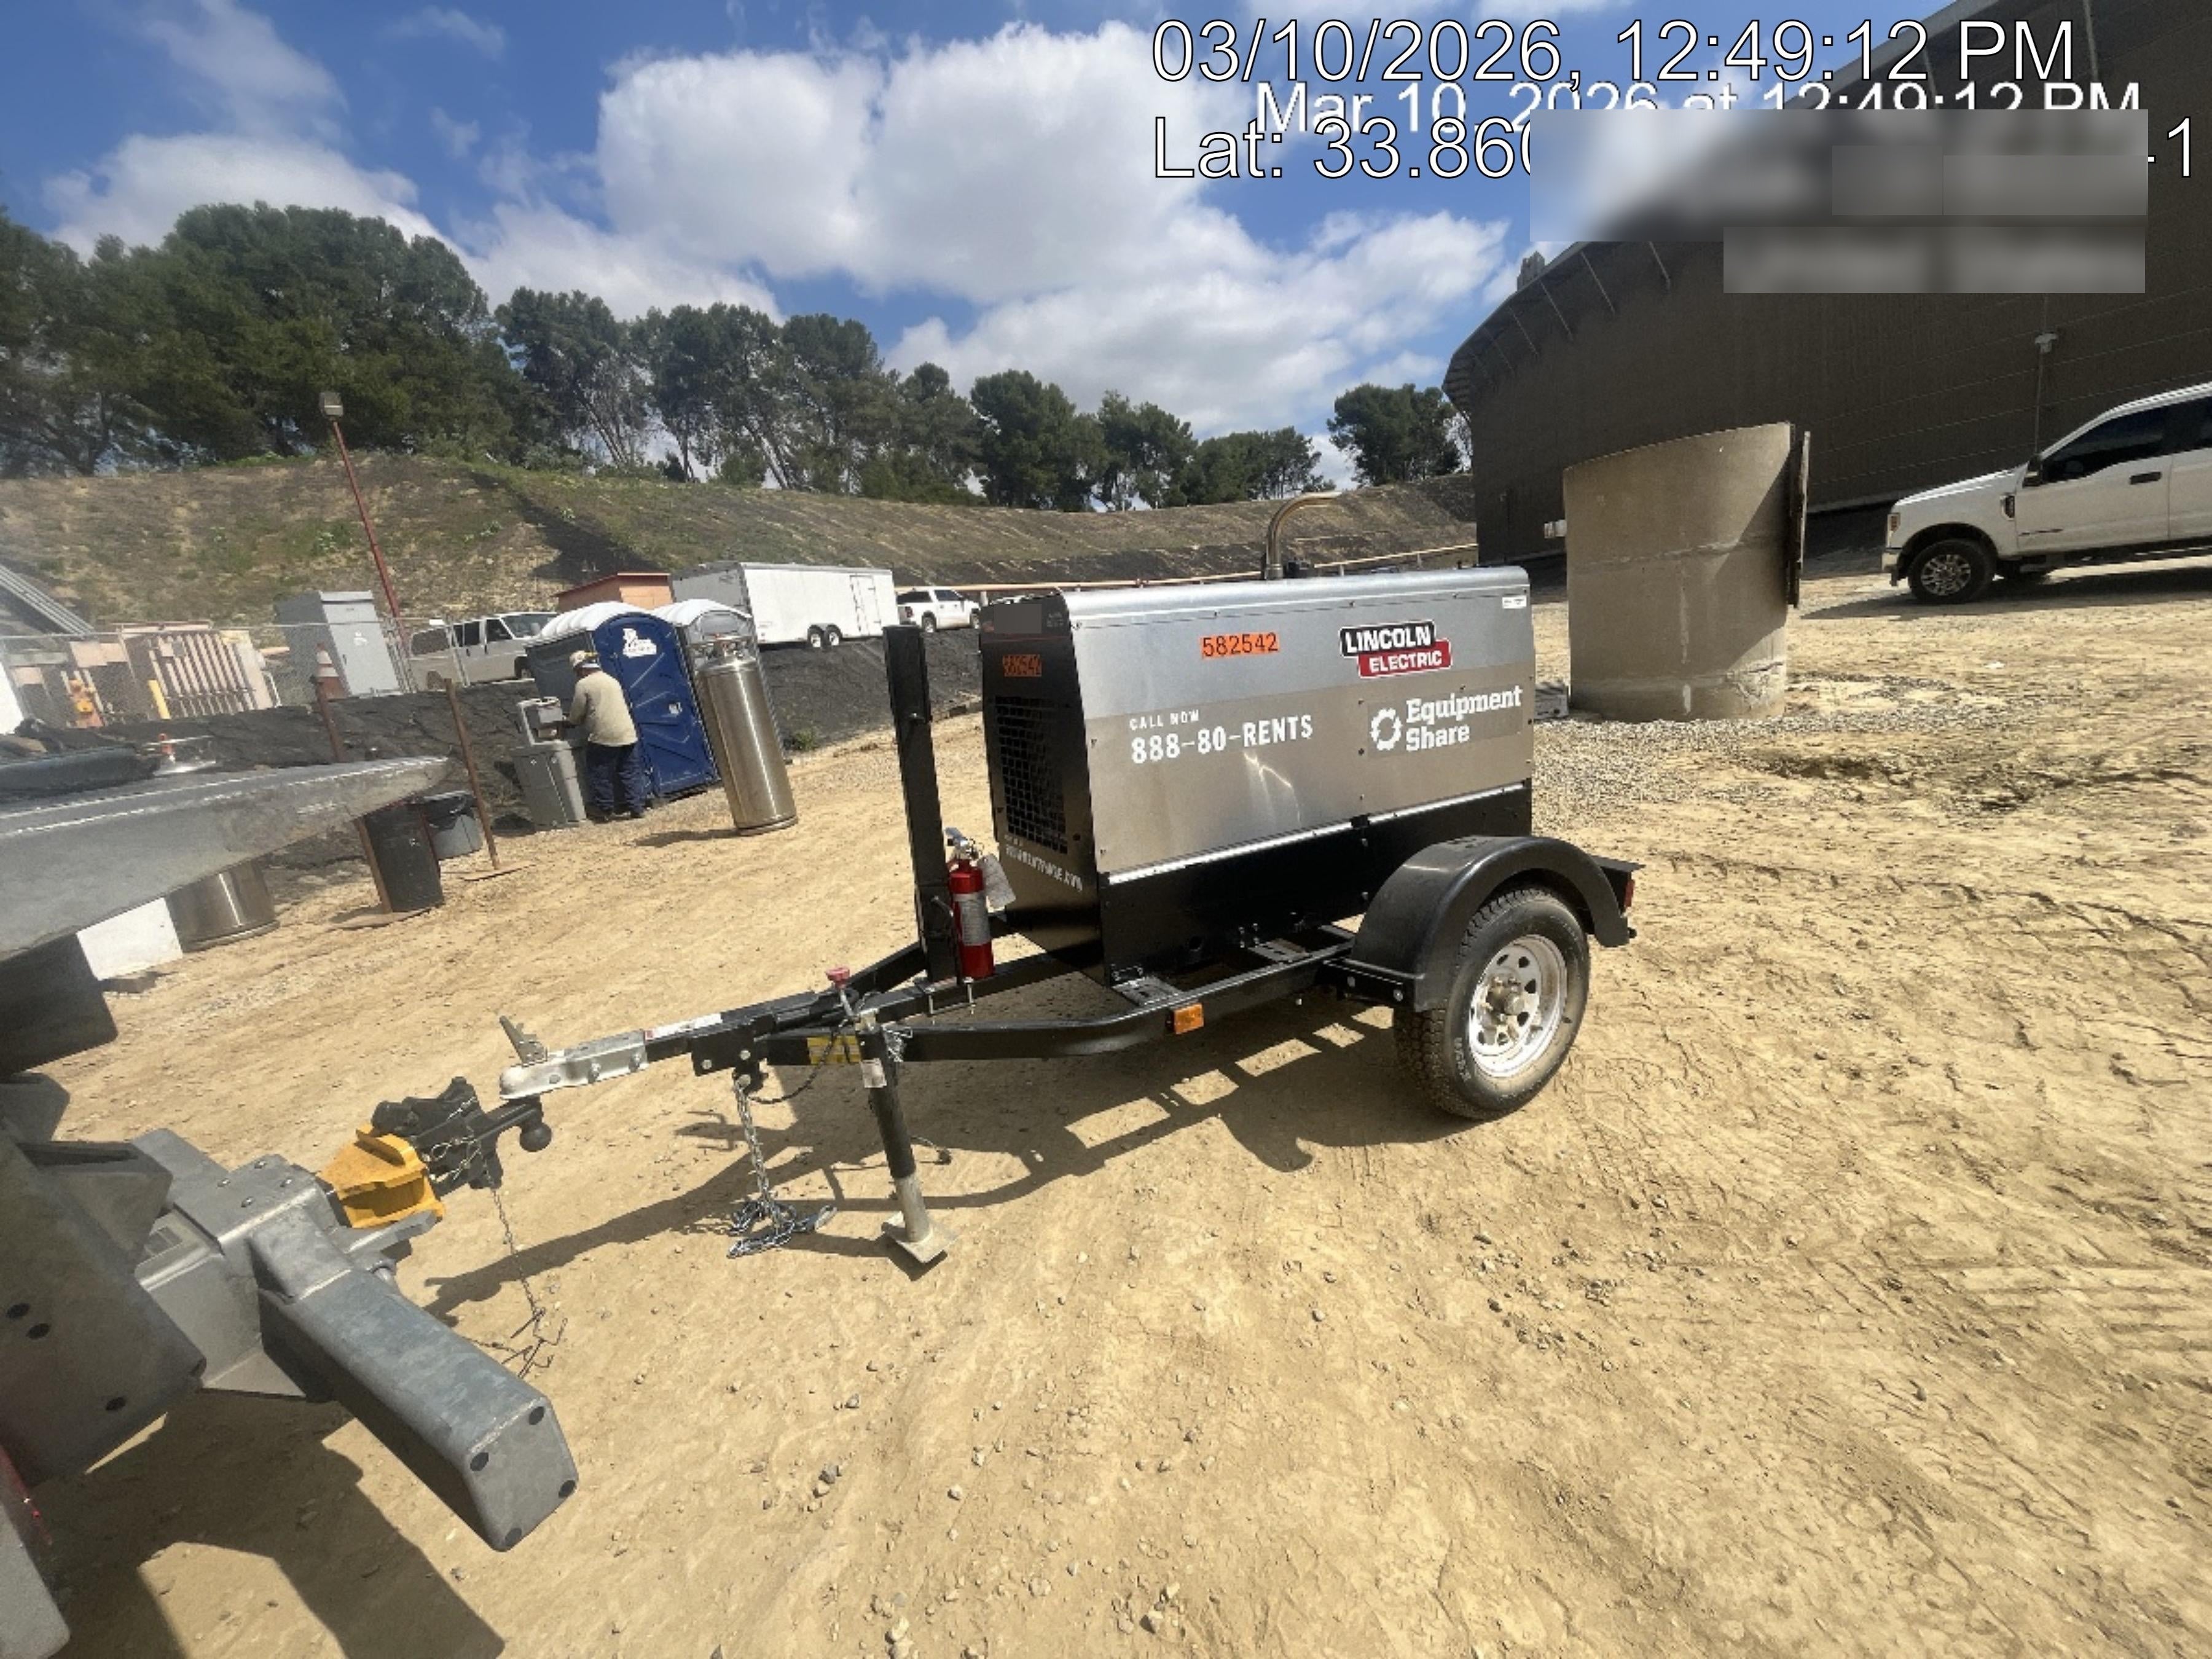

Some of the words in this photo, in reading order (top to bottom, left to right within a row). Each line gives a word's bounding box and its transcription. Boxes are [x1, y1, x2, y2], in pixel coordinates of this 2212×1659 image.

[1202, 632, 1278, 657] 582542
[1344, 624, 1431, 653] LINCOLN
[1369, 649, 1442, 673] ELECTRIC
[1406, 684, 1523, 725] Equipment
[1129, 715, 1163, 731] CALL
[1170, 710, 1199, 725] NOW
[1131, 714, 1313, 764] 888-80-RENTS
[1406, 724, 1470, 752] Share
